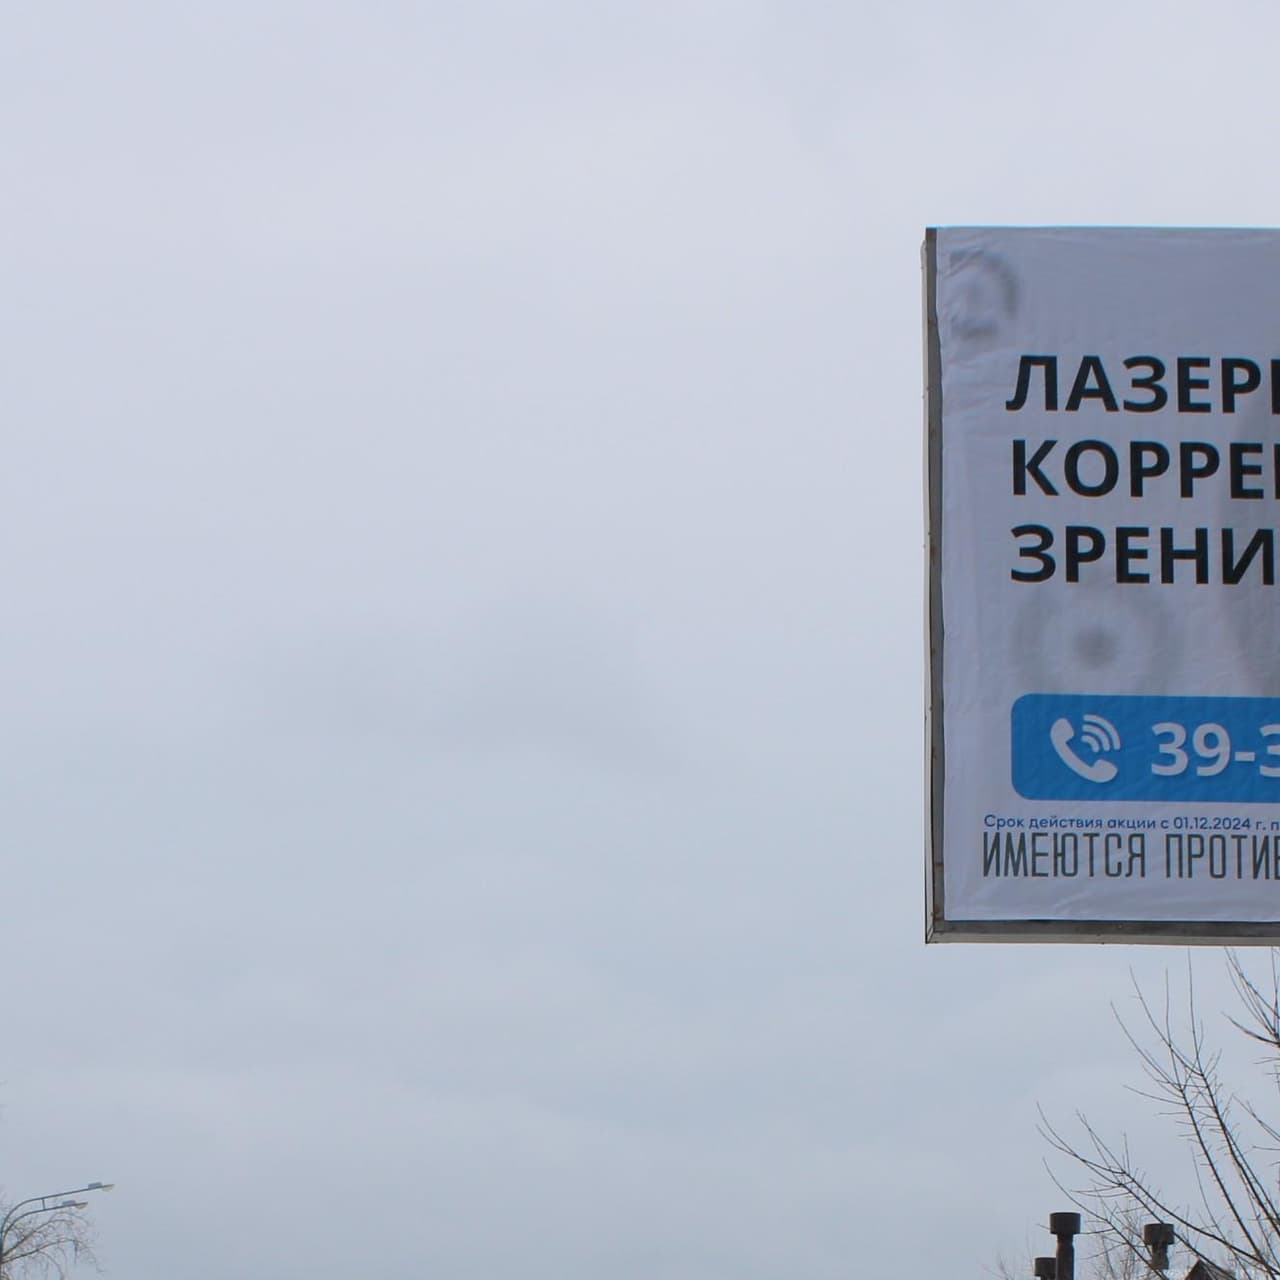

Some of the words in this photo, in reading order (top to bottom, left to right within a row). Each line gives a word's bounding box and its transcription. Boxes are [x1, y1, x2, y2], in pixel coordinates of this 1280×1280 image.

[983, 814, 1024, 830] Срок
[1028, 814, 1103, 830] действия
[1107, 818, 1156, 831] акции
[1173, 816, 1251, 831] 01.12.2024
[1255, 820, 1267, 832] г.
[982, 831, 1147, 878] ИМЕЮТСЯ
